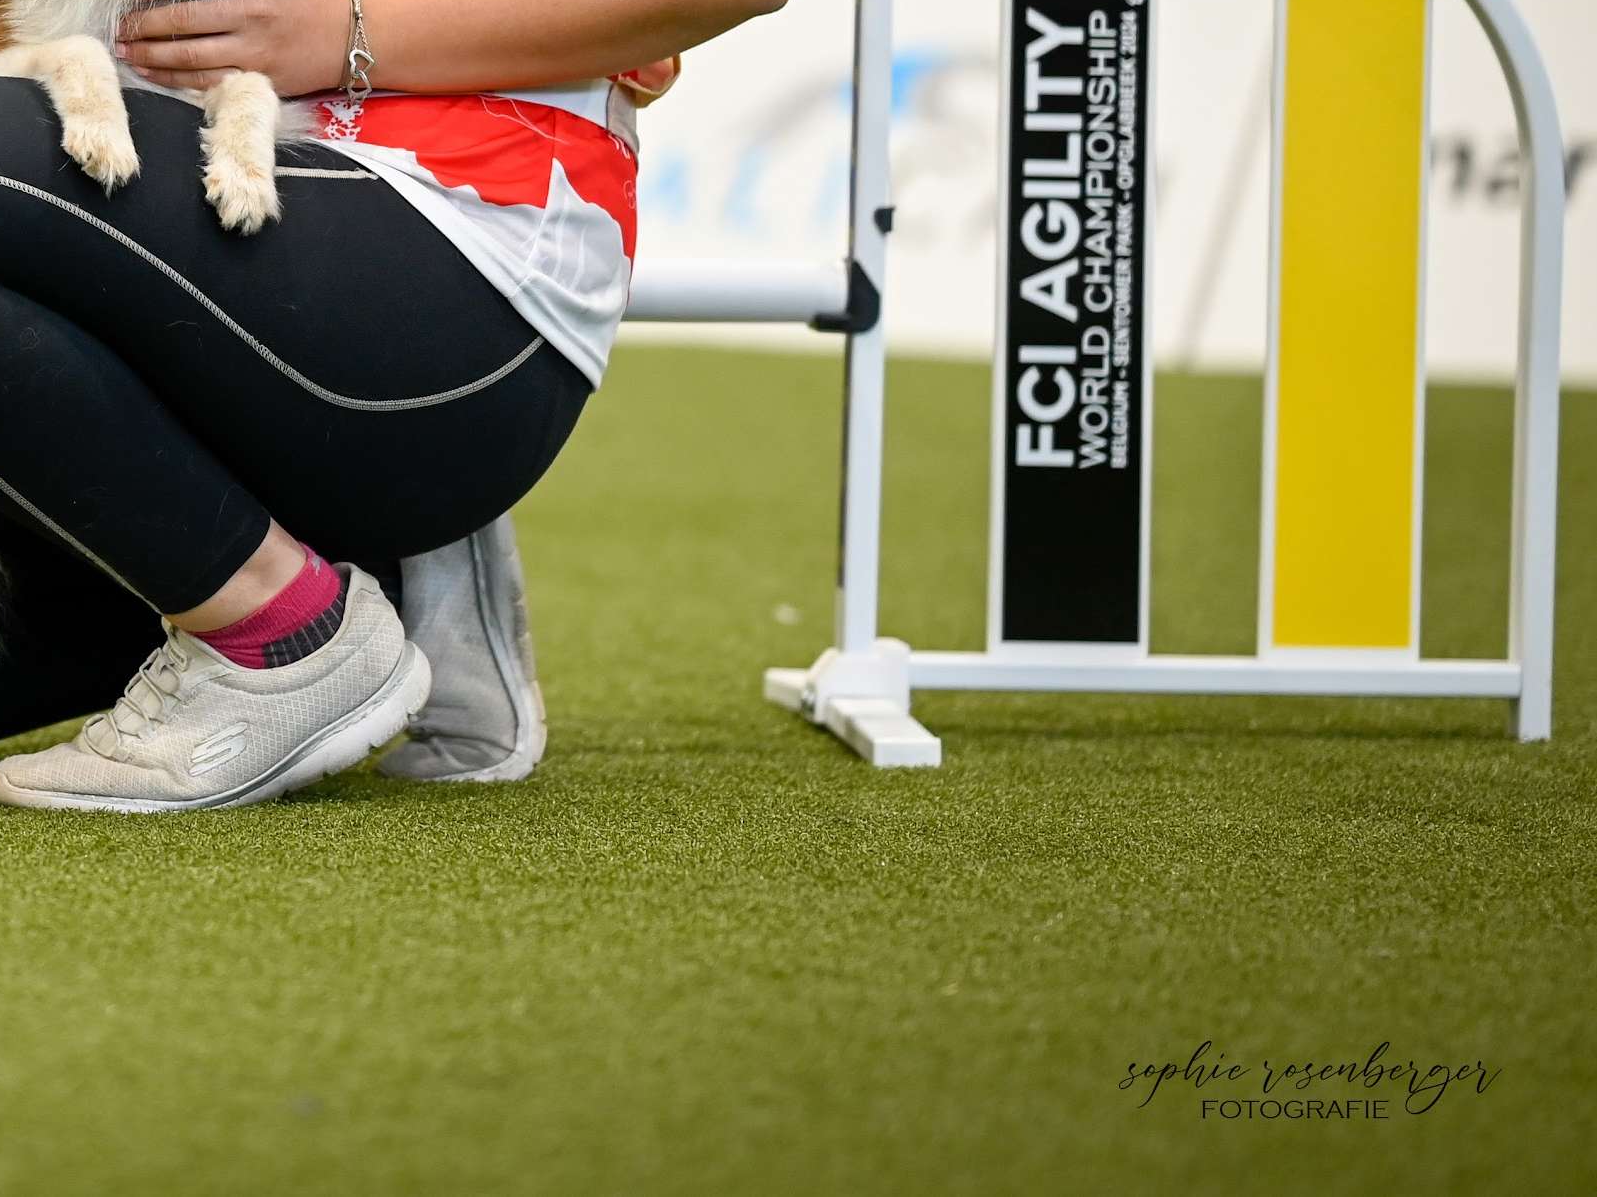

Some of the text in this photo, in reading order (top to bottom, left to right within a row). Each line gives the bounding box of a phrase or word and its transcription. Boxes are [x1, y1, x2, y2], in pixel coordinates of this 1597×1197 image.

[1015, 6, 1085, 467] FCI AGILITY
[1078, 9, 1117, 469] WORLD CHAMPIONSHIP
[1115, 202, 1134, 257] PARK
[1110, 380, 1130, 469] BELGIUM
